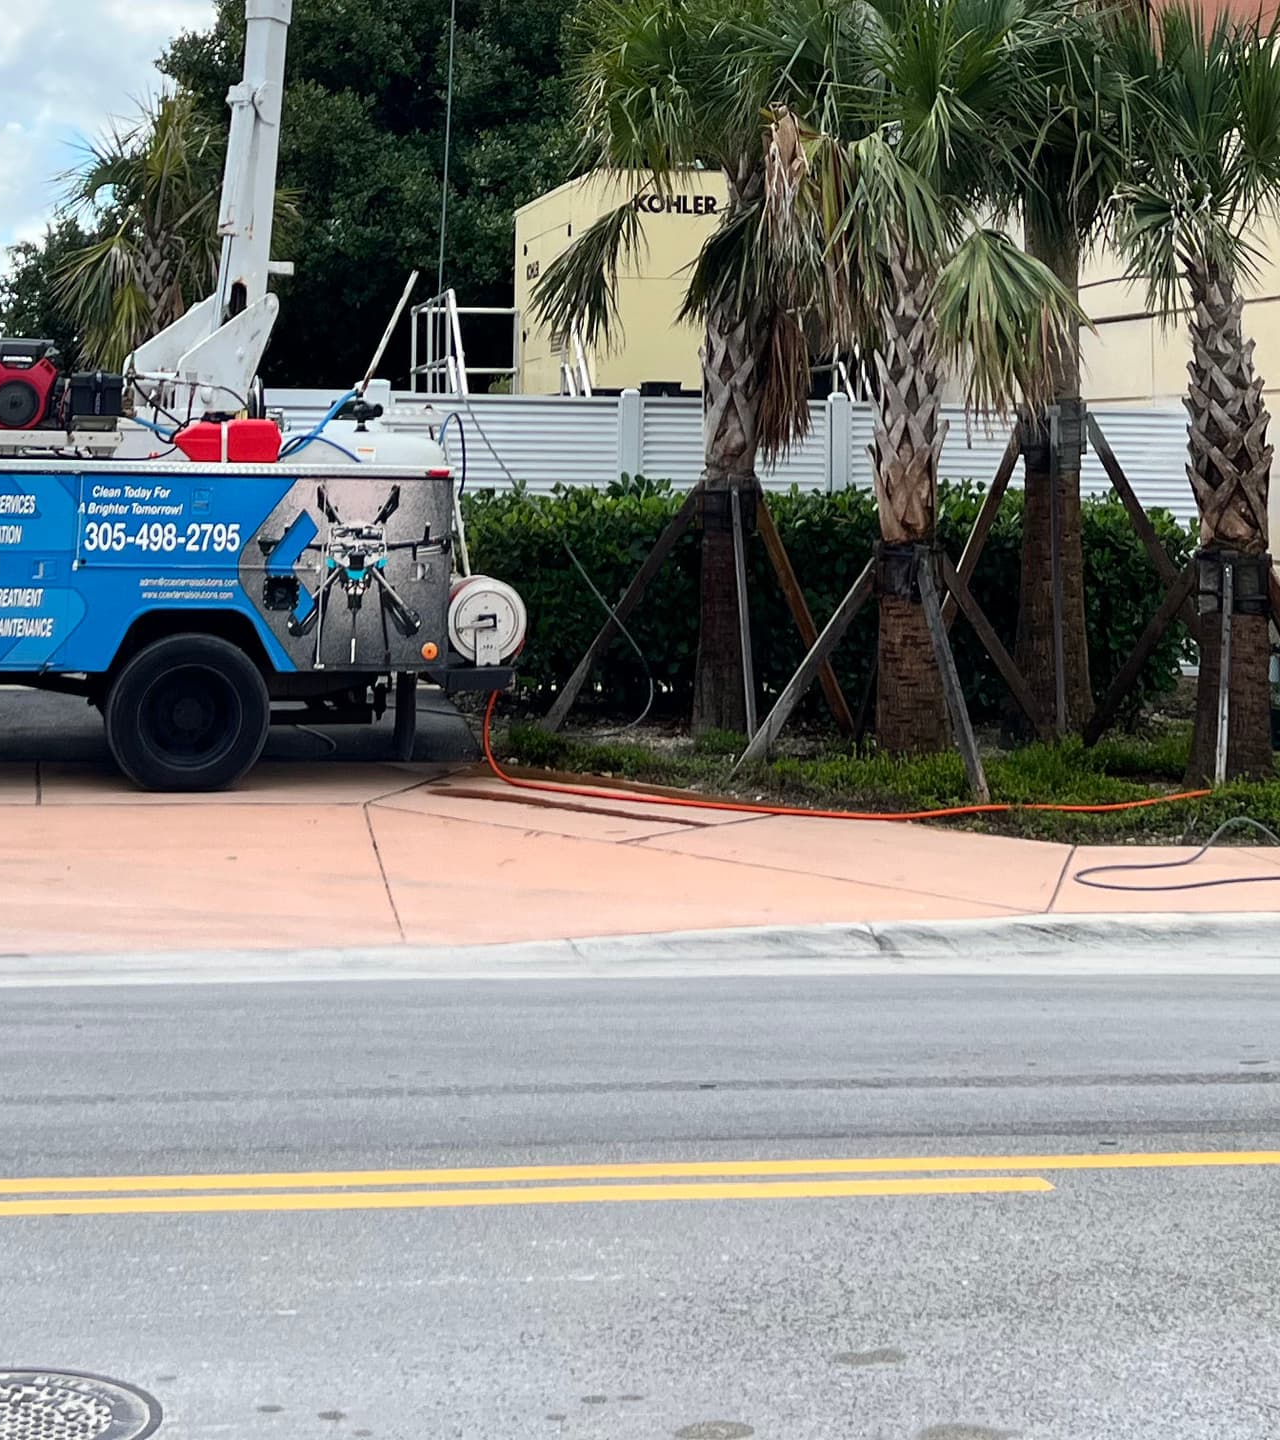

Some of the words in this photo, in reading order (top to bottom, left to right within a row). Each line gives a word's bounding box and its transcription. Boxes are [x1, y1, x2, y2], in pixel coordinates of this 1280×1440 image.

[634, 194, 717, 214] KOHLER
[92, 485, 121, 498] Clean
[123, 486, 152, 500] Today
[153, 486, 171, 498] For
[78, 502, 86, 513] A
[88, 502, 129, 517] Brighter
[131, 503, 183, 515] Tomorrow!
[84, 521, 241, 552] 305-498-2795
